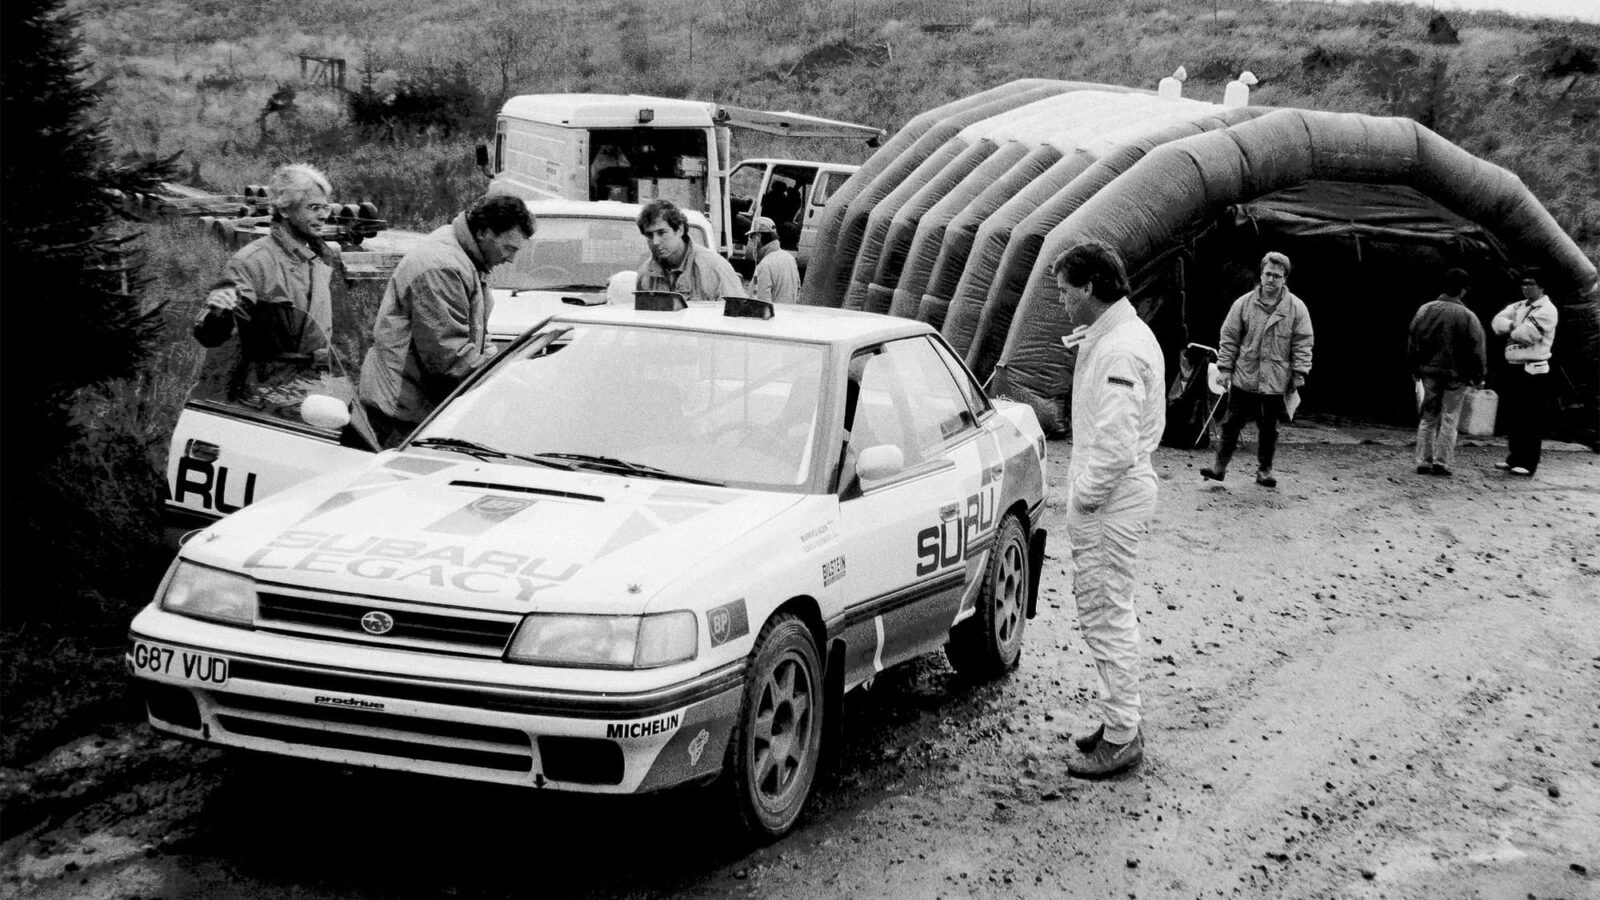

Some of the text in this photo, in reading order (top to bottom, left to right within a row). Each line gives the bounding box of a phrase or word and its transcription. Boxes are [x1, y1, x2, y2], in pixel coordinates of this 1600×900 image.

[262, 529, 585, 582] SUBARU
[242, 550, 568, 601] LEGACY
[713, 612, 729, 634] BP
[134, 643, 227, 684] G87 VUD
[314, 695, 386, 709] prodrive
[606, 713, 679, 739] MICHELIN
